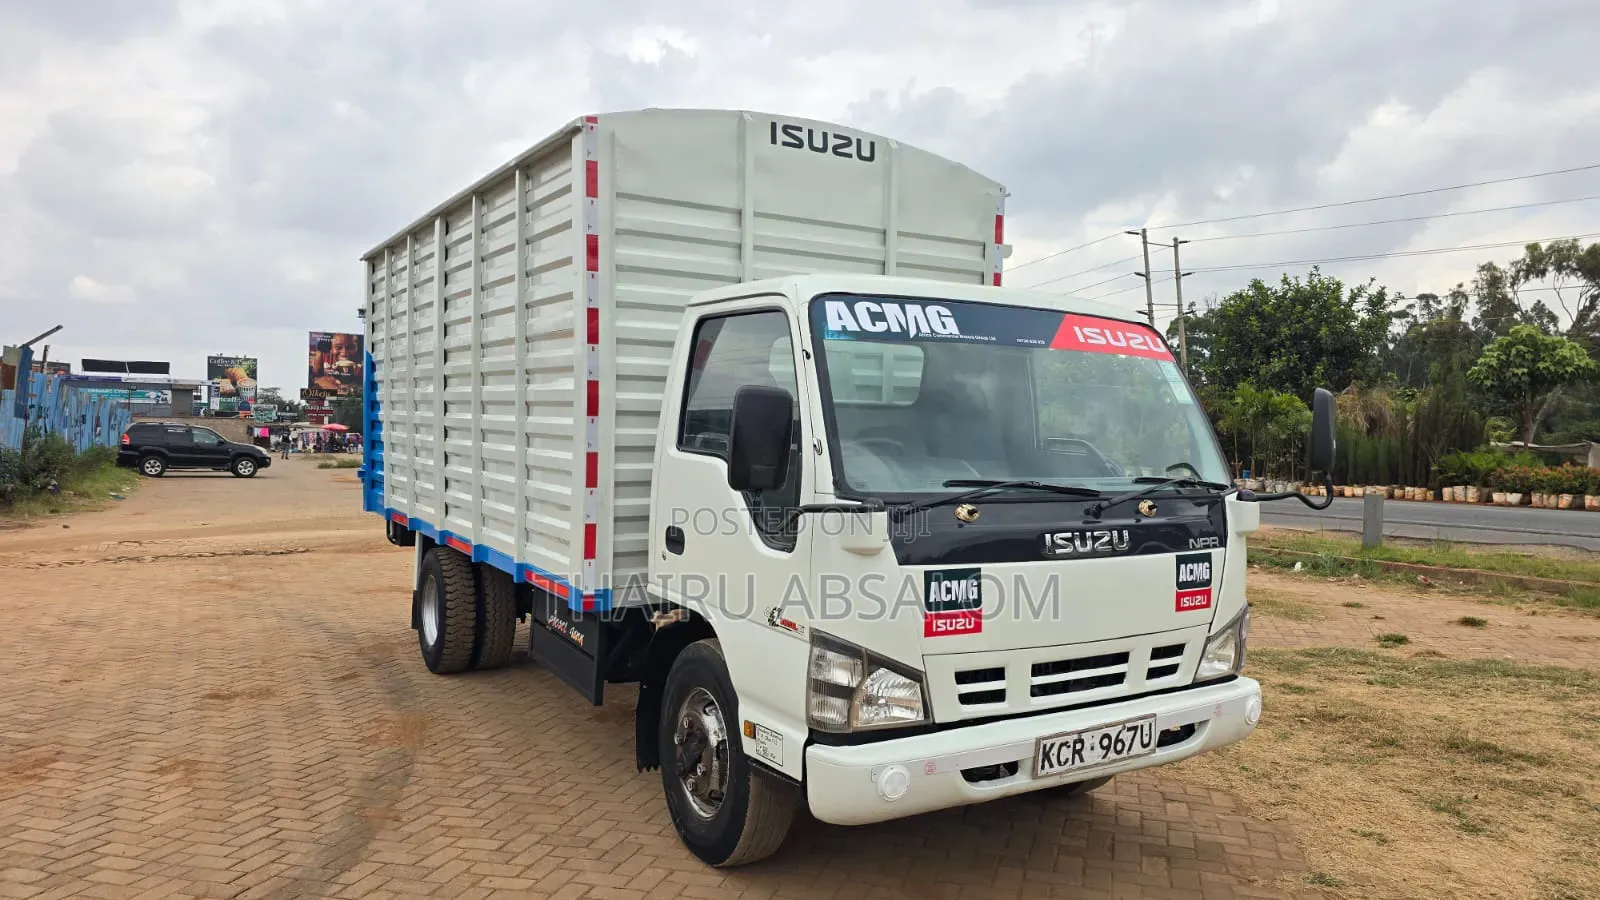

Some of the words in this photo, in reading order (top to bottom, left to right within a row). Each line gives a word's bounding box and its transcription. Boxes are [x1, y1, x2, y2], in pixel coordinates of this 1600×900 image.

[770, 121, 875, 162] ISUZU
[824, 301, 960, 338] ACMG
[1073, 326, 1166, 352] ISUZU
[1044, 529, 1129, 554] ISUZU
[1189, 536, 1219, 549] NPR
[1179, 562, 1210, 584] ACMG
[929, 579, 979, 605] ACMG
[1180, 594, 1207, 607] ISUZU
[932, 617, 975, 632] ISUZU
[1041, 738, 1085, 770] KCR
[1099, 723, 1153, 760] 967U
